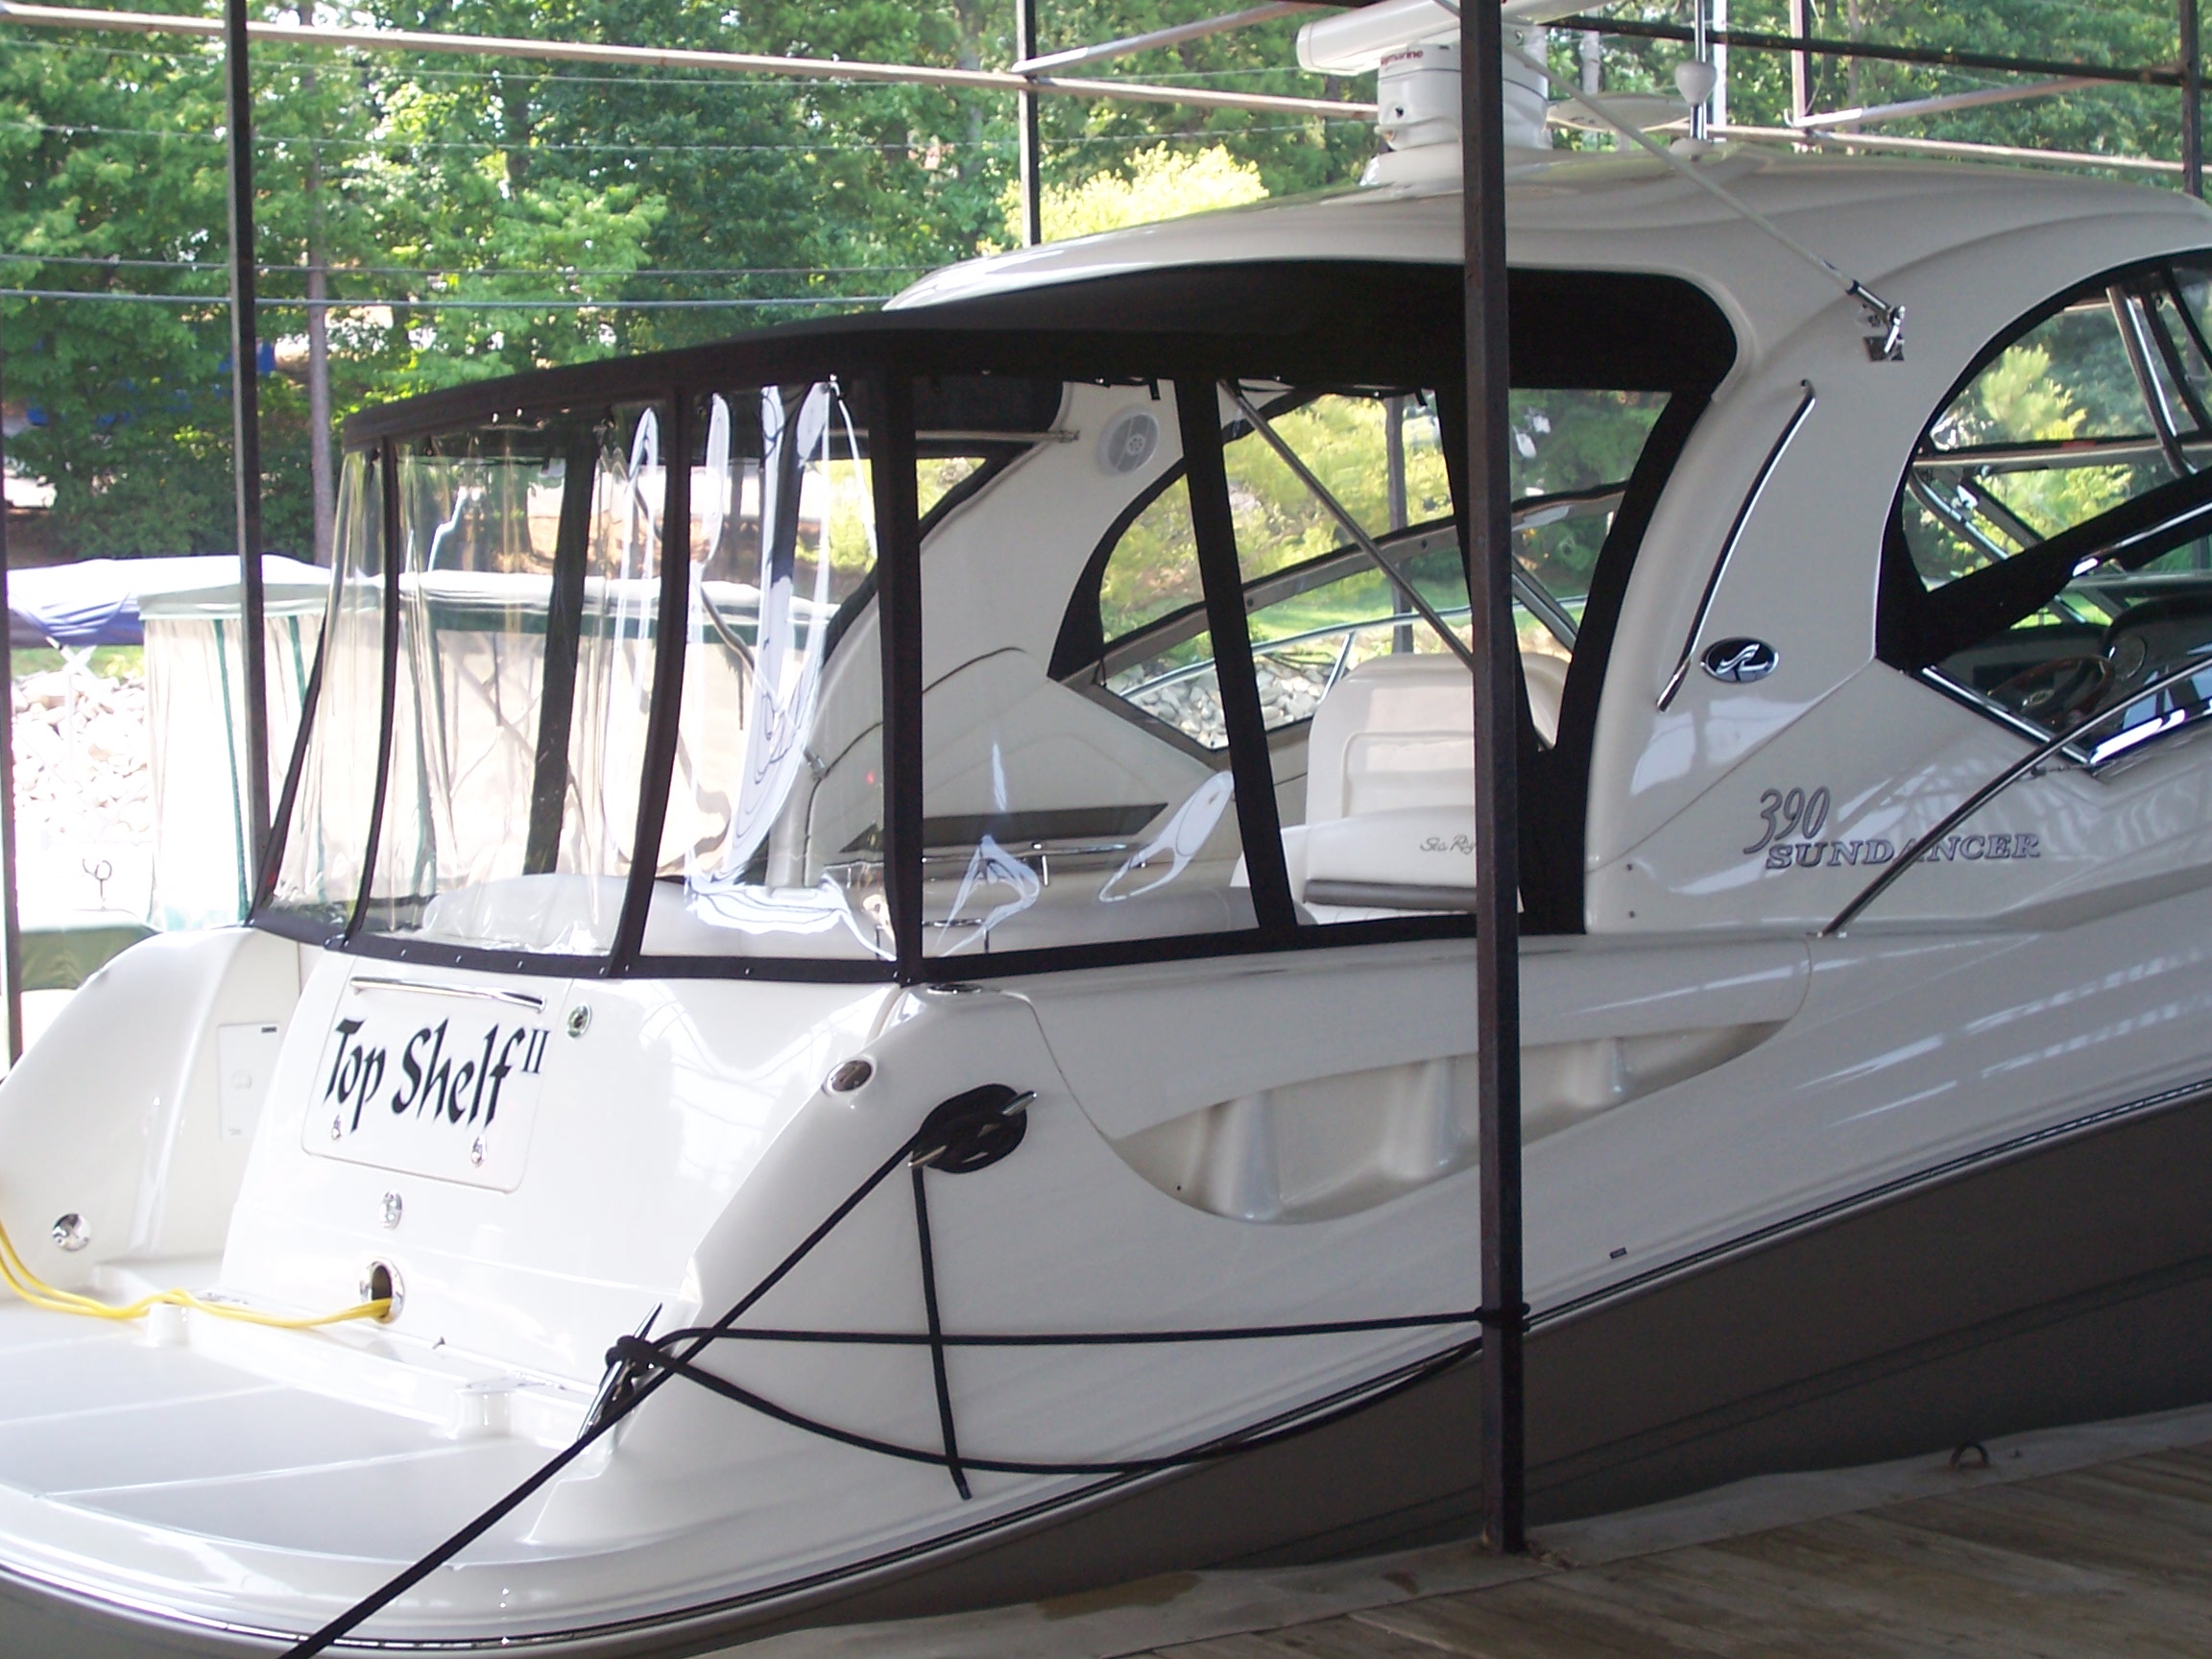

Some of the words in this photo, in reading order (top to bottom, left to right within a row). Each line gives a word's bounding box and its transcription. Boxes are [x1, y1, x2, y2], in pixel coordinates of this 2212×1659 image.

[1420, 837, 1448, 852] Sea
[1743, 786, 1831, 854] 390
[324, 1018, 386, 1133] Top
[391, 1018, 525, 1129] Shelf
[522, 1029, 550, 1073] II
